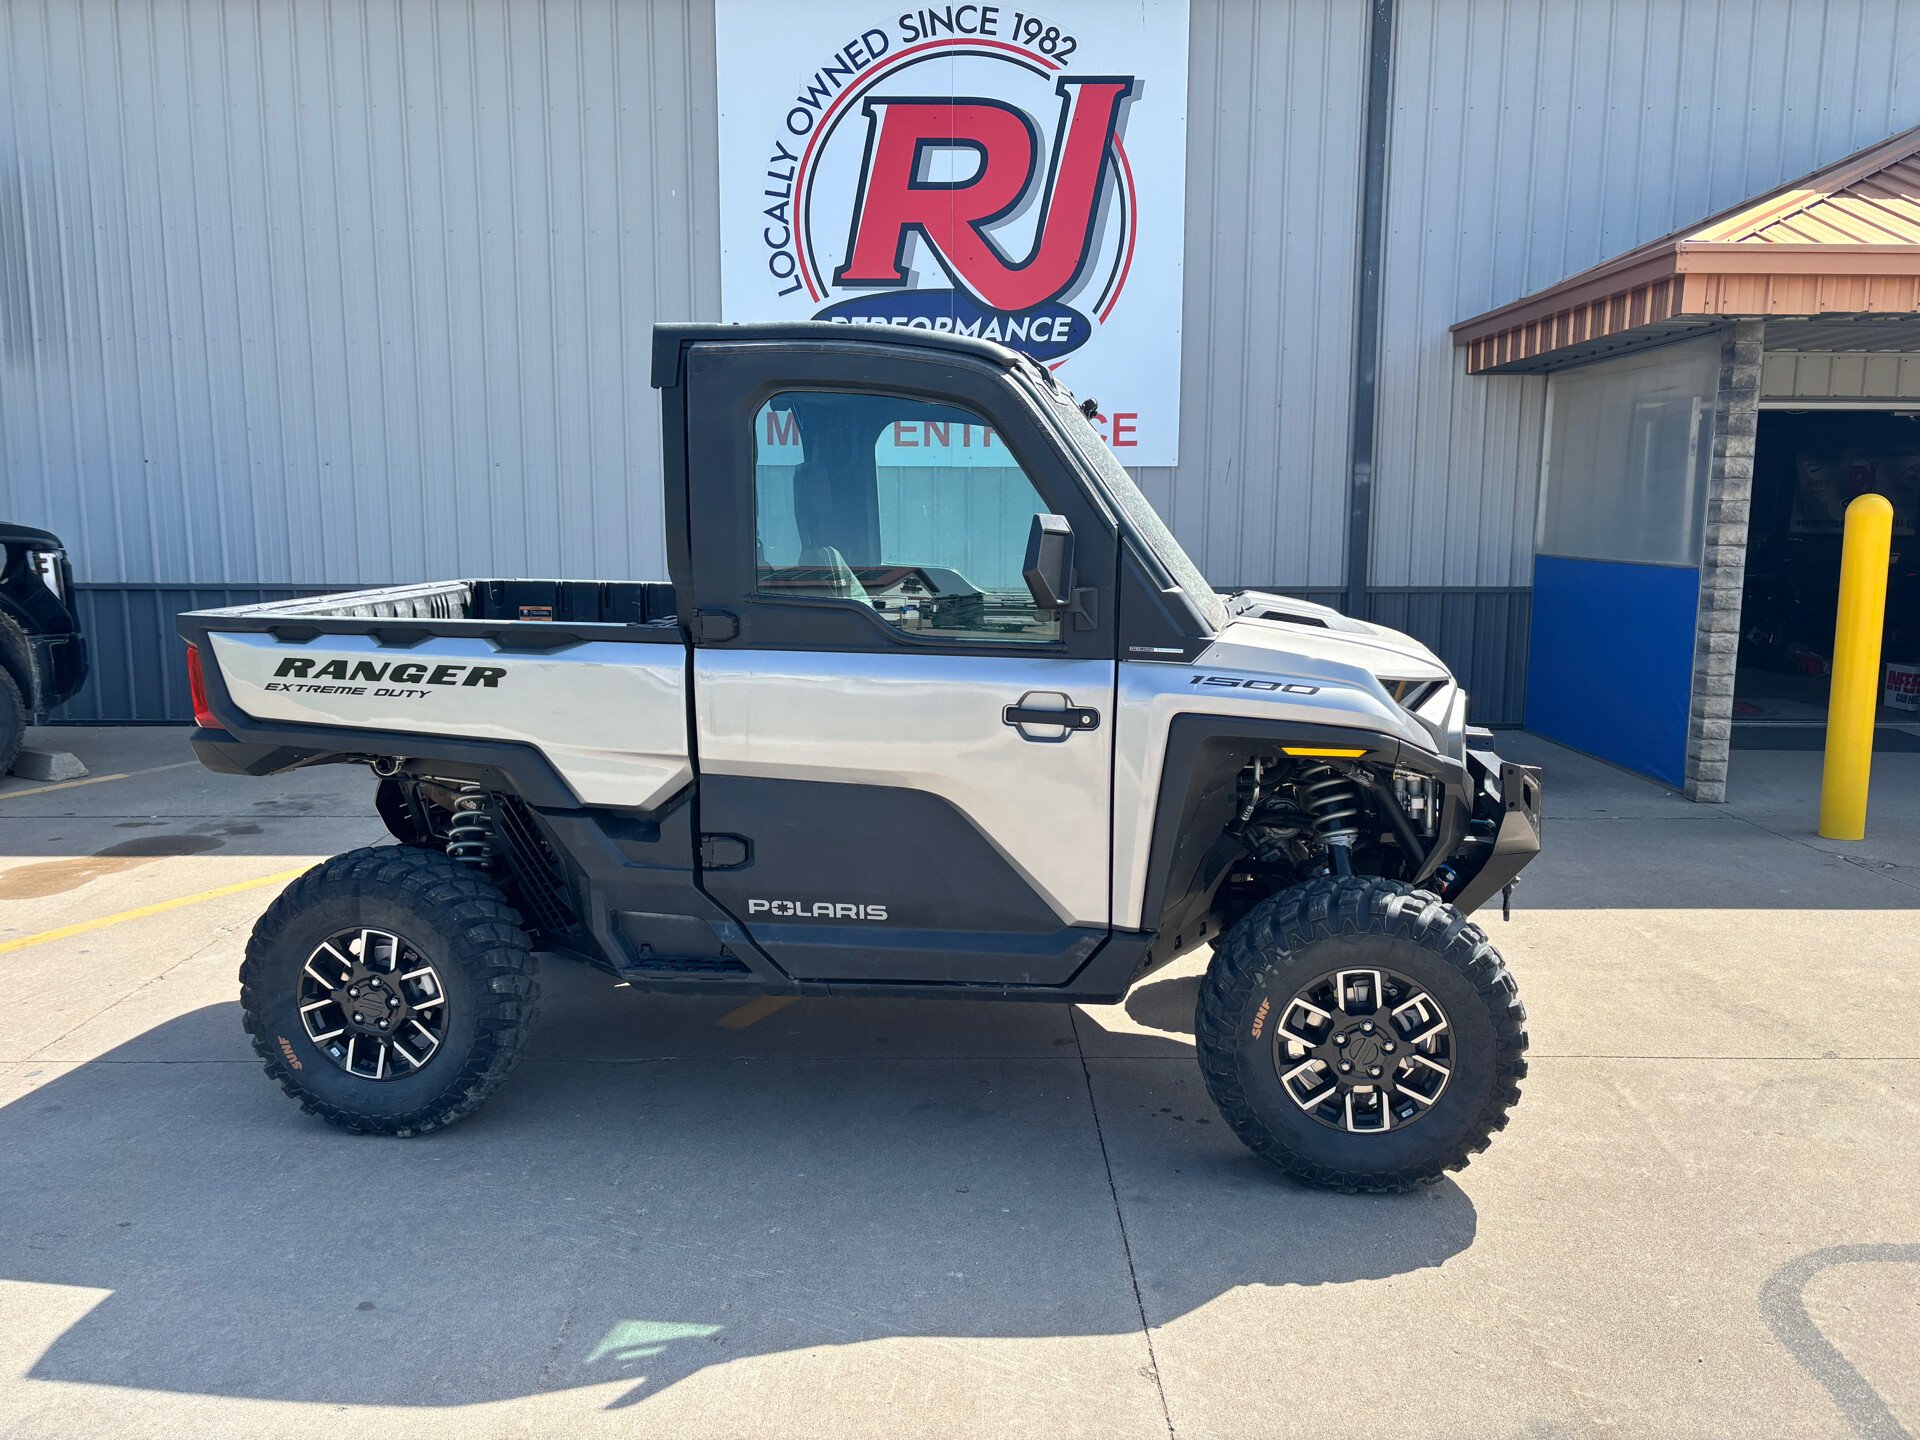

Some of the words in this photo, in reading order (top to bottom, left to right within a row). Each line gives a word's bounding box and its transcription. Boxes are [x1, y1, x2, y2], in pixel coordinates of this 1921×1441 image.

[763, 140, 803, 297] LOCALLY
[786, 28, 890, 136] OWNED
[899, 4, 1000, 43] SINCE
[1012, 12, 1078, 67] 1982
[832, 75, 1136, 313] RJ
[273, 657, 508, 688] RANGER
[1189, 675, 1321, 696] 1500
[264, 682, 368, 696] EXTREME
[373, 688, 433, 699] DUTY
[748, 899, 889, 921] POLARIS
[1251, 996, 1270, 1040] SUNF
[277, 1035, 303, 1071] SUNF
